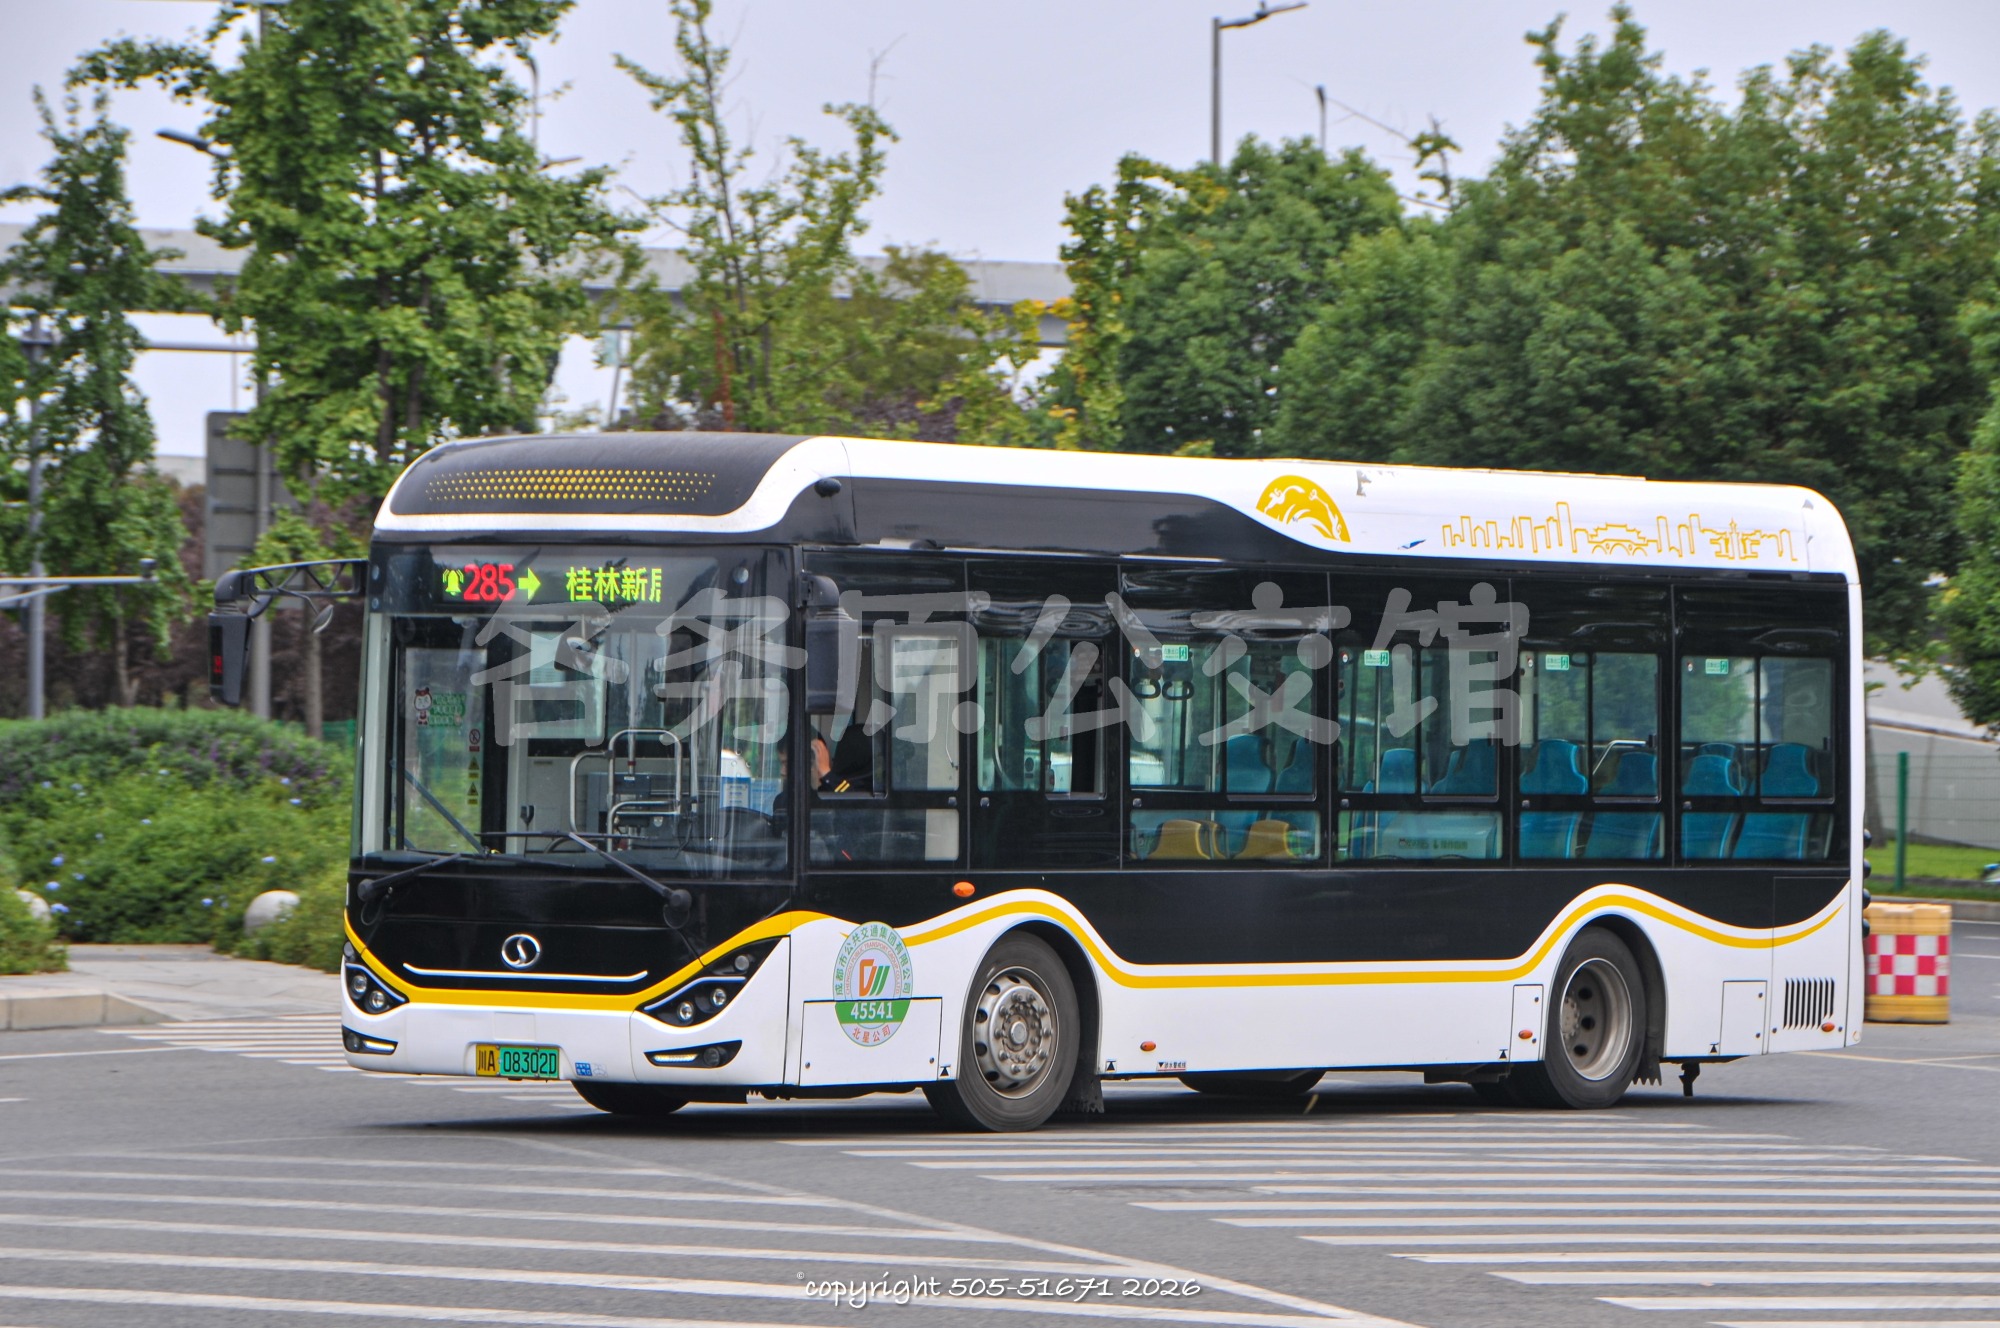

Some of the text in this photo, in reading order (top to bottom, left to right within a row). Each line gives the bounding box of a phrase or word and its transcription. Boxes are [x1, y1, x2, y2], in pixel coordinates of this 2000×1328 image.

[463, 563, 516, 602] 285
[863, 941, 888, 953] TRANSPORT
[834, 924, 912, 996] 成都市公共交通集团有限公司
[850, 1002, 893, 1020] 45541
[852, 1024, 891, 1044] 北星公司
